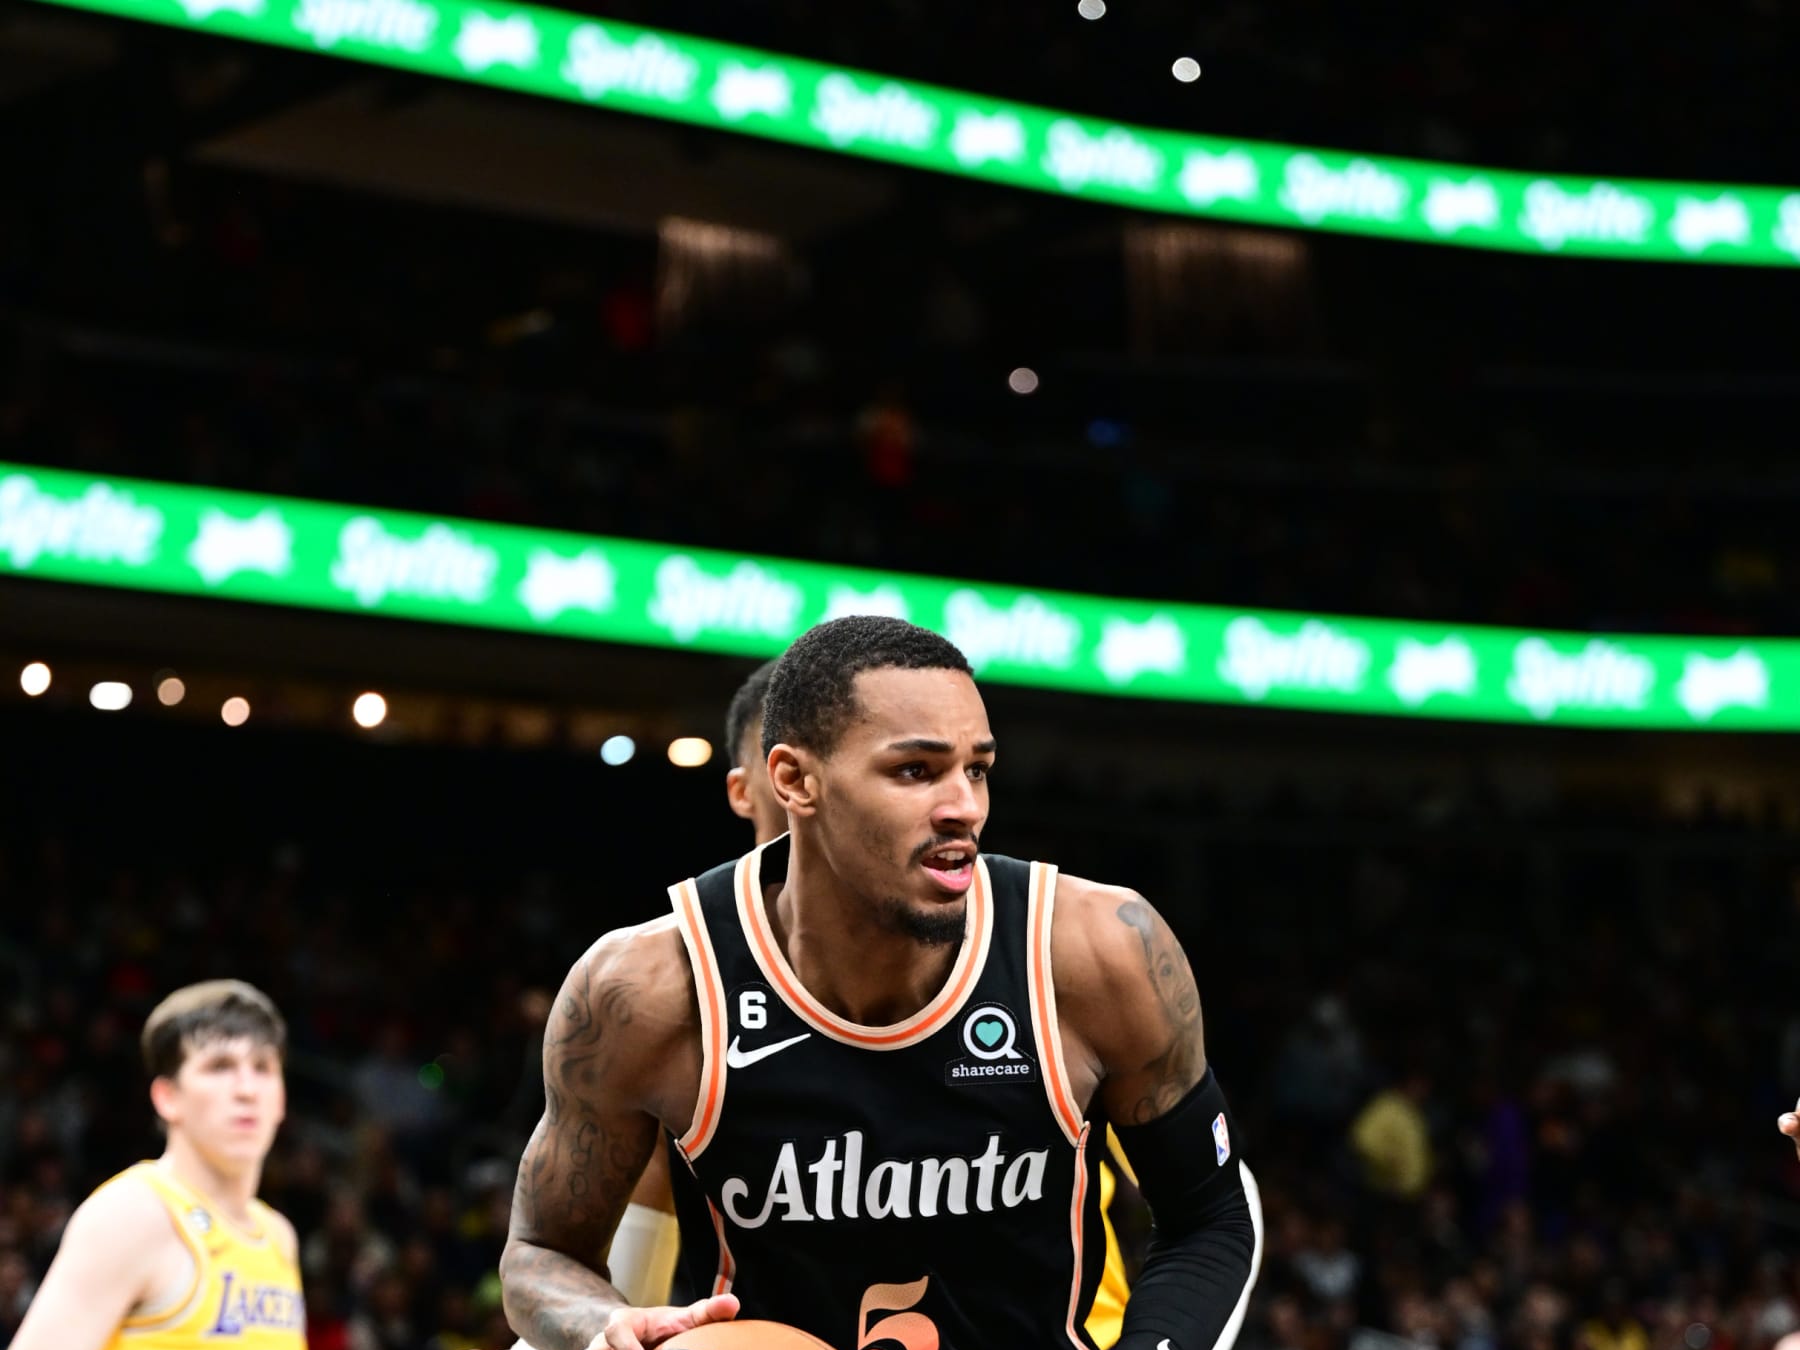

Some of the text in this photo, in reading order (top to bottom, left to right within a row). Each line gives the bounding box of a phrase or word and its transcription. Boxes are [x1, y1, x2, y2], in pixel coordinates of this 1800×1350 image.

[740, 991, 766, 1029] 6
[952, 1063, 1030, 1078] sharecare
[722, 1131, 1050, 1229] Atlanta
